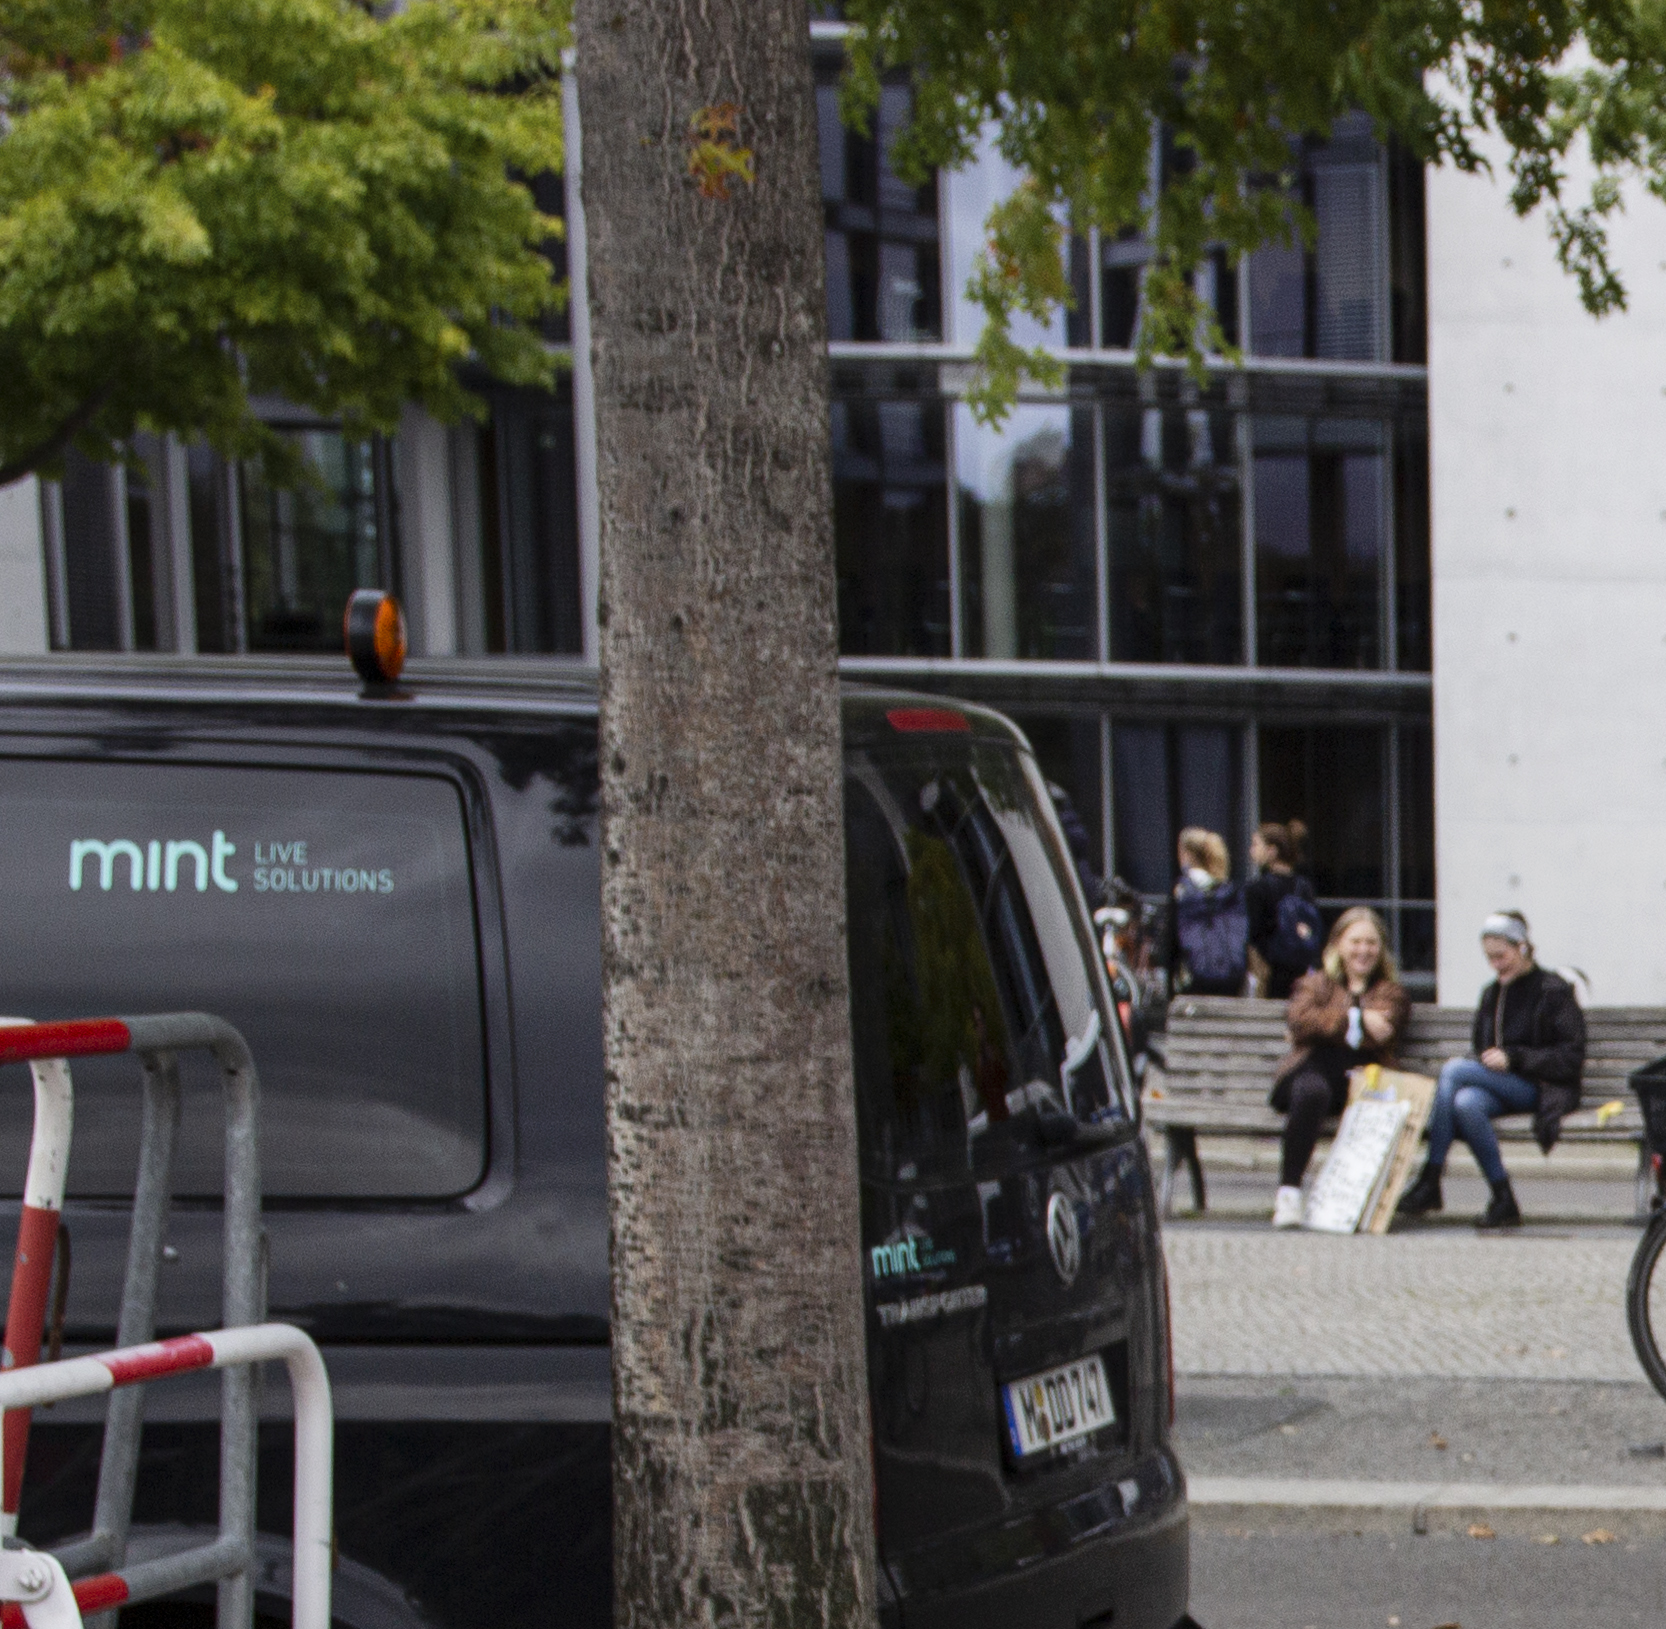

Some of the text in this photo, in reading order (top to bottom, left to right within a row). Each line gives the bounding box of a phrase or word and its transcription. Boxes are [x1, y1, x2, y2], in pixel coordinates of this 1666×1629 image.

[69, 829, 239, 893] mint
[254, 841, 308, 865] LIVE
[253, 868, 395, 894] SOLUTIONS
[871, 1232, 922, 1280] mint
